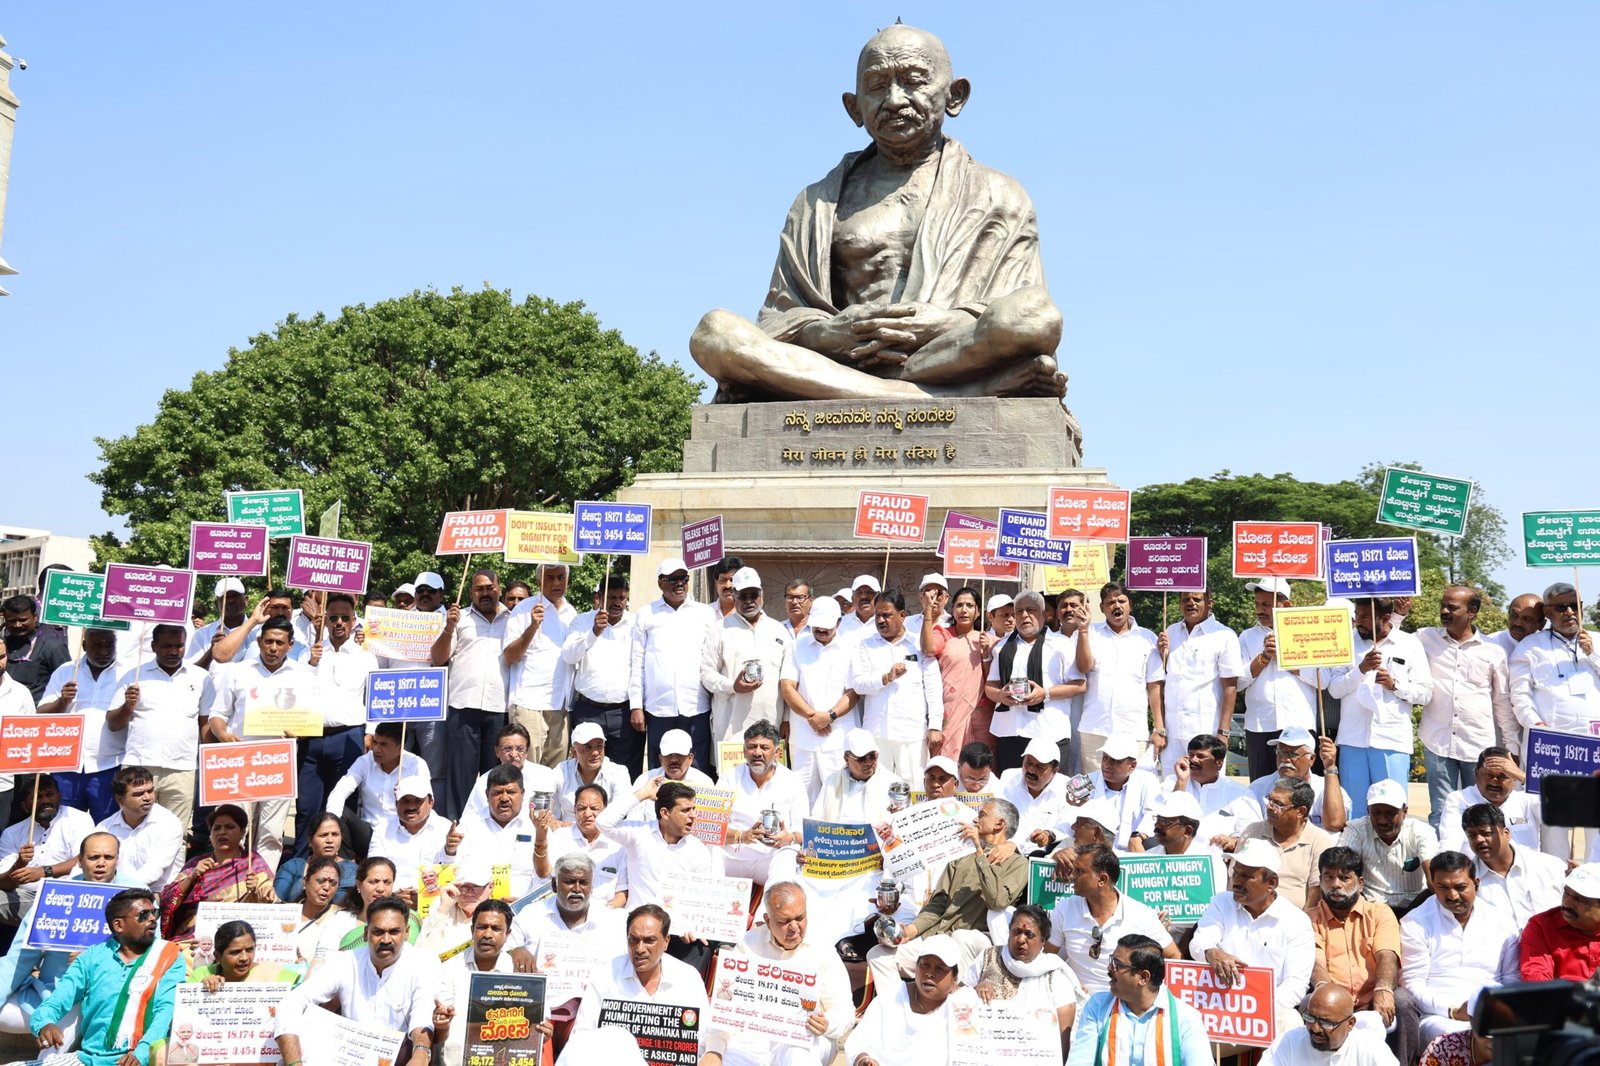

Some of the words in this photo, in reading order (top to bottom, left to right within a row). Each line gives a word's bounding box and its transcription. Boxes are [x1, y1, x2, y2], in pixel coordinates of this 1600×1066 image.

[785, 410, 811, 431] ನನ್ನ
[815, 408, 872, 424] ಜೀವನವೇ
[876, 408, 902, 430] ನನ್ನ
[906, 406, 956, 423] ಸಂದೇಶ
[782, 447, 804, 461] मेरा
[812, 448, 847, 461] जीवन
[854, 446, 868, 461] ही
[875, 446, 897, 459] मेरा
[945, 442, 956, 459] है
[1396, 486, 1428, 500] ಹೊಟ್ಟೆಗೆ
[864, 495, 911, 509] FRAUD
[1055, 495, 1087, 508] ಮೋಸ
[1093, 497, 1126, 510] ಮೋಸ
[448, 514, 496, 526] FRAUD
[868, 508, 915, 523] FRAUD
[1008, 515, 1045, 527] DEMAND
[1059, 514, 1081, 531] ಮತ್ತೆ
[1087, 514, 1120, 528] ಮೋಸ
[451, 525, 499, 537] FRAUD
[511, 520, 533, 530] DON'T
[536, 521, 561, 531] INSULT
[685, 528, 701, 541] RELEASE
[701, 525, 709, 536] THE
[710, 522, 719, 533] FULL
[872, 522, 920, 537] FRAUD
[1536, 527, 1572, 538] ಹೊಟ್ಟೆಗೆ
[521, 532, 550, 542] DIGNITY
[554, 535, 567, 543] FOR
[604, 529, 623, 540] 3454
[1238, 530, 1272, 543] ಮೋಸ
[1279, 531, 1314, 544] ಮೋಸ
[455, 537, 503, 549] FRAUD
[687, 538, 704, 552] DROUGHT
[706, 534, 718, 546] RELIEF
[949, 536, 980, 548] ಮೋಸ
[1002, 536, 1045, 548] RELEASED
[1047, 540, 1070, 551] ONLY
[297, 542, 330, 556] RELEASE
[332, 547, 346, 558] THE
[347, 548, 364, 560] FULL
[519, 544, 567, 555] KANNADIGAS
[694, 549, 711, 562] AMOUNT
[1006, 547, 1027, 557] 3454
[1030, 550, 1062, 561] CRORES
[1362, 550, 1383, 561] 18171
[1386, 546, 1408, 560] ಕೋಟಿ
[298, 557, 335, 570] DROUGHT
[336, 560, 360, 573] RELIEF
[953, 552, 974, 569] ಮತ್ತೆ
[1243, 549, 1266, 568] ಮತ್ತೆ
[1272, 550, 1308, 563] ಮೋಸ
[310, 572, 343, 585] AMOUNT
[1364, 570, 1386, 581] 3454
[1389, 567, 1412, 580] ಕೋಟಿ
[59, 587, 92, 600] ಹೊಟ್ಟೆಗೆ
[391, 610, 438, 620] GOVERNMENT
[1284, 616, 1319, 625] ಕರ್ನಾಟಕ
[1324, 615, 1342, 623] ಜನರ
[392, 622, 429, 630] BETRAYING
[383, 631, 438, 640] KANNADIGAS
[1283, 648, 1308, 660] ಮೋಸ
[398, 697, 417, 708] 3454
[2, 723, 40, 738] ಮೋಸ
[45, 723, 80, 736] ಮೋಸ
[7, 743, 32, 763] ಮತ್ತೆ
[38, 743, 72, 756] ಮೋಸ
[1534, 738, 1560, 765] ಕೇಳಿದ್ದು
[1565, 744, 1588, 762] 18171
[206, 754, 245, 769] ಮೋಸ
[251, 751, 288, 766] ಮೋಸ
[213, 773, 239, 794] ಮತ್ತೆ
[246, 772, 284, 787] ಮೋಸ
[818, 826, 830, 834] ಬರ
[832, 827, 864, 835] ಪರಿಹಾರ
[1165, 861, 1206, 872] HUNGRY,
[1131, 876, 1168, 888] HUNGRY
[1171, 875, 1201, 886] ASKED
[45, 889, 74, 914] ಕೇಳಿದ್ದು
[77, 893, 104, 909] 18171
[1144, 891, 1162, 902] FOR
[1164, 891, 1188, 901] MEAL
[1162, 904, 1182, 915] FEW
[36, 913, 69, 939] ಕೊಟ್ಟಿದ್ದು
[72, 918, 100, 934] 3454
[723, 958, 749, 972] ಬರ
[757, 964, 816, 986] ಪರಿಹಾರ
[782, 985, 799, 995] ಕೋಟಿ
[602, 1001, 621, 1011] MODI
[622, 1002, 672, 1016] GOVERNMENT
[675, 1008, 682, 1017] IS
[781, 998, 799, 1008] ಕೋಟಿ
[1180, 990, 1257, 1014] FRAUD
[198, 1006, 231, 1017] ಕನ್ನಡಿಗರಿಗೆ
[234, 1006, 253, 1015] ಮೋದಿ
[486, 1007, 524, 1020] ಕನ್ನಡಿಗರಿಗೆ
[242, 1017, 261, 1025] ಮೋಸ
[604, 1011, 660, 1026] HUMILIATING
[663, 1017, 679, 1027] THE
[1203, 1014, 1268, 1037] RAUD
[481, 1020, 529, 1040] ಮೋಸ
[632, 1026, 641, 1034] OF
[642, 1026, 679, 1038] KARNATAKA
[682, 1030, 699, 1040] WITH
[674, 1041, 697, 1052] CRORES
[651, 1050, 676, 1061] ASKED
[679, 1053, 696, 1063] AND
